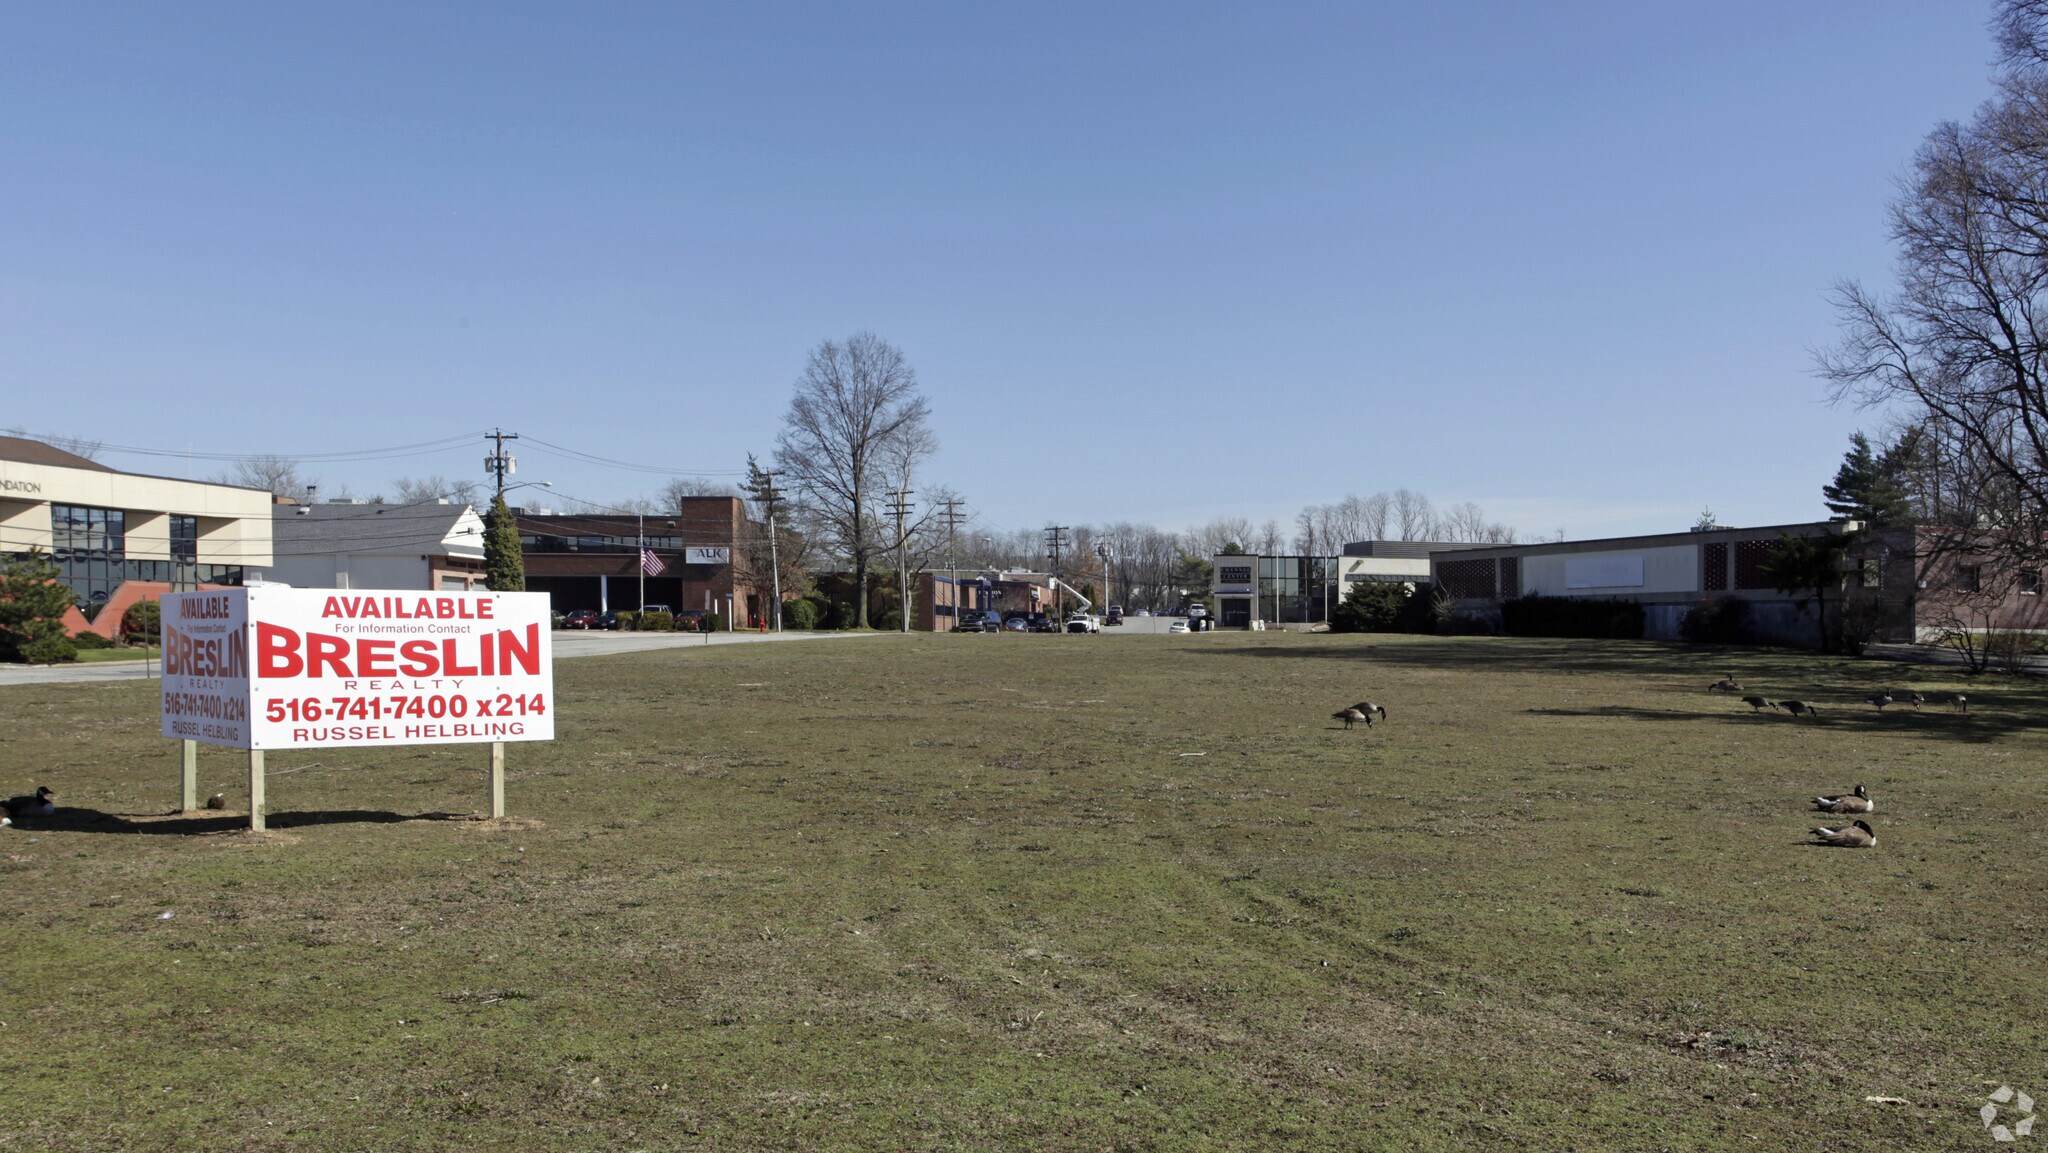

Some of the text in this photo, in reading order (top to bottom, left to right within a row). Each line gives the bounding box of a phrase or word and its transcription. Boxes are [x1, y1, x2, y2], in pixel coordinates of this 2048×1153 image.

[696, 549, 721, 558] ALK
[180, 596, 229, 619] AVAILABLE
[321, 596, 494, 619] AVAILABLE
[335, 623, 471, 634] For Information Contact
[166, 621, 248, 678] BRESLIN
[256, 620, 540, 678] BRESLIN
[189, 679, 225, 690] REALTY
[345, 679, 464, 690] REALTY
[165, 692, 245, 721] 516-741-7400 x214
[266, 693, 546, 723] 516-741-7400 x214
[172, 720, 239, 741] RUSSEL HELBLING
[293, 722, 524, 741] RUSSEL HELBLING
